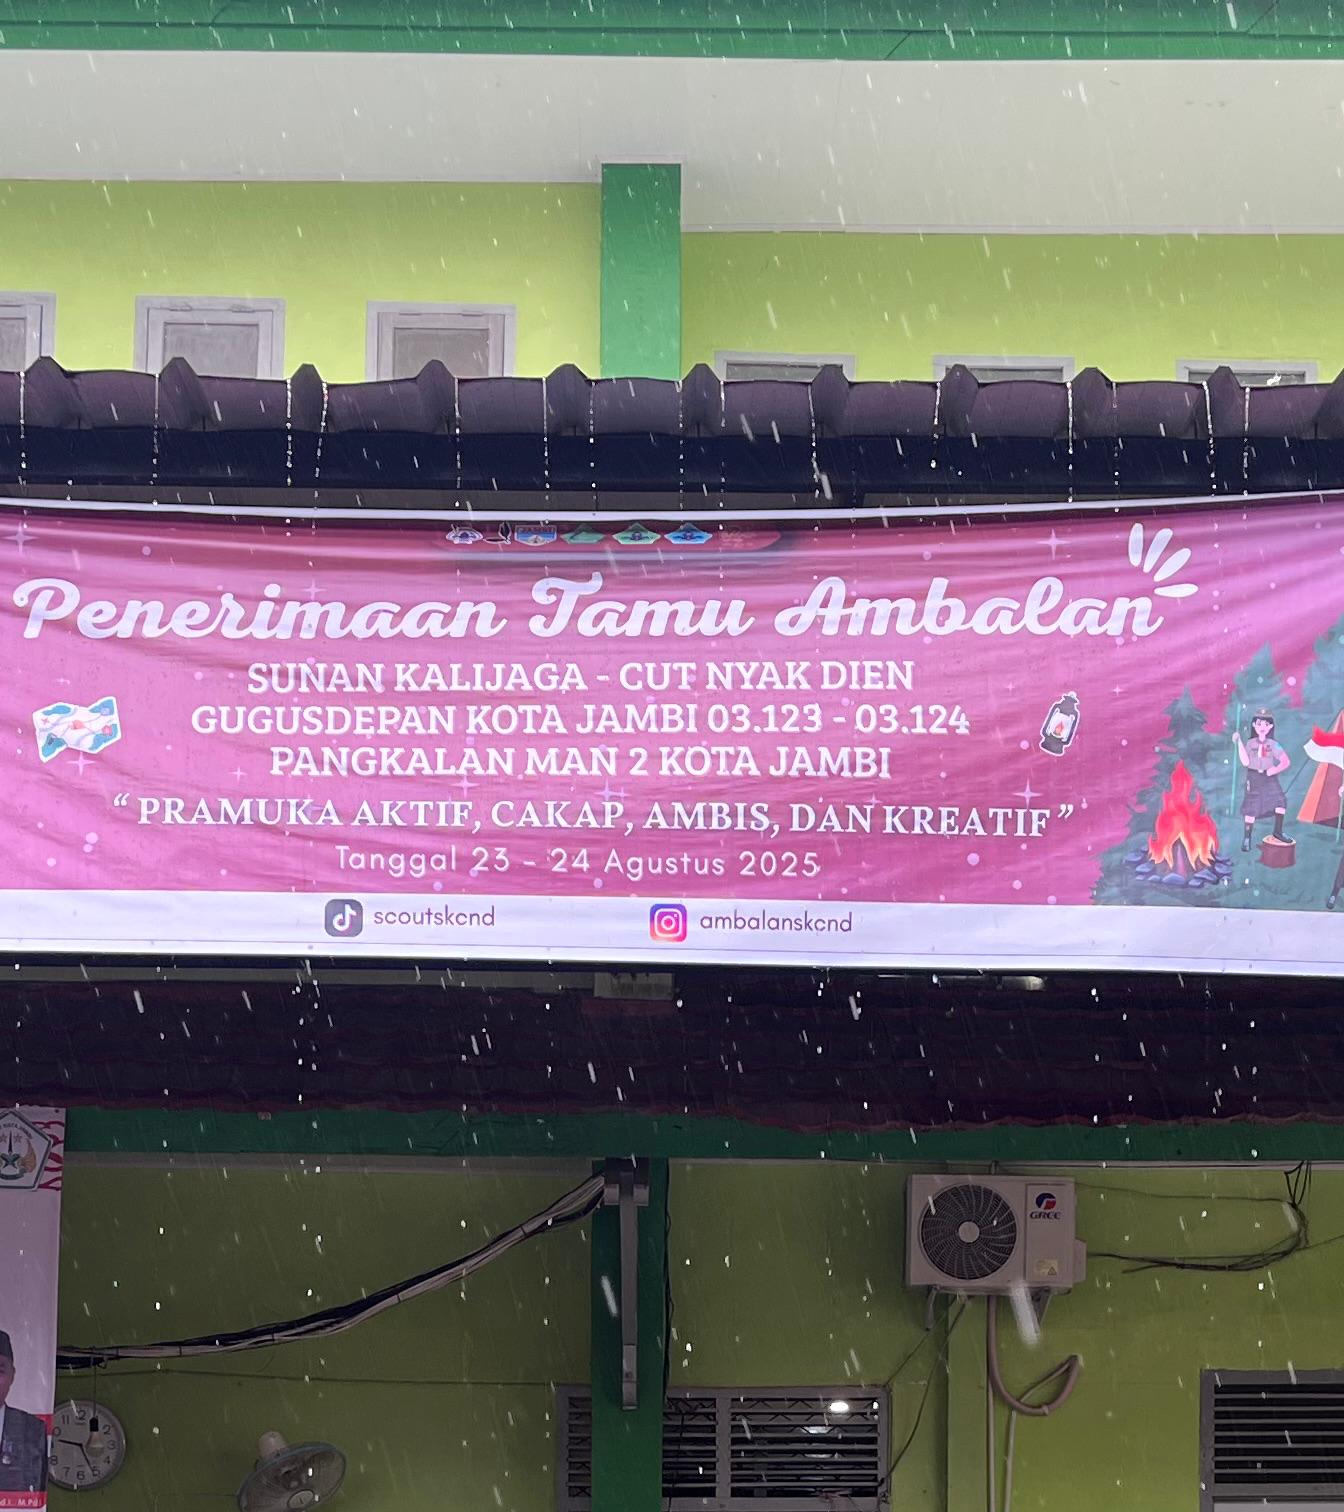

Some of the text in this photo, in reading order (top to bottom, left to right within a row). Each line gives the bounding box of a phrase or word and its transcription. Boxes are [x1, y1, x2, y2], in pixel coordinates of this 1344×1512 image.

[12, 570, 1167, 641] Penerimaan Tamu Ambalan
[248, 662, 383, 693] SUNAN
[394, 662, 586, 693] KALIJAGA
[619, 662, 696, 691] CUT
[705, 662, 809, 690] NYAK
[820, 661, 915, 691] DIEN
[191, 704, 456, 735] GUGUSDEPAN
[466, 705, 567, 735] KOTA
[575, 703, 698, 734] JAMBI
[707, 704, 823, 735] 03.123
[855, 704, 971, 736] 03.124
[269, 745, 892, 779] PANGKALAN MAN 2 KOTA JAMBI
[351, 799, 481, 834] AKTIF,
[490, 801, 634, 835] CAKAP,
[642, 802, 781, 838] AMBIS,
[790, 803, 873, 834] DAN
[336, 845, 457, 878] Tanggal
[472, 848, 511, 874] 23
[551, 848, 590, 874] 24
[604, 850, 725, 882] Agustus
[740, 851, 821, 878] 2025
[373, 904, 496, 928] scoutskcnd
[699, 911, 854, 934] ambalanskcnd
